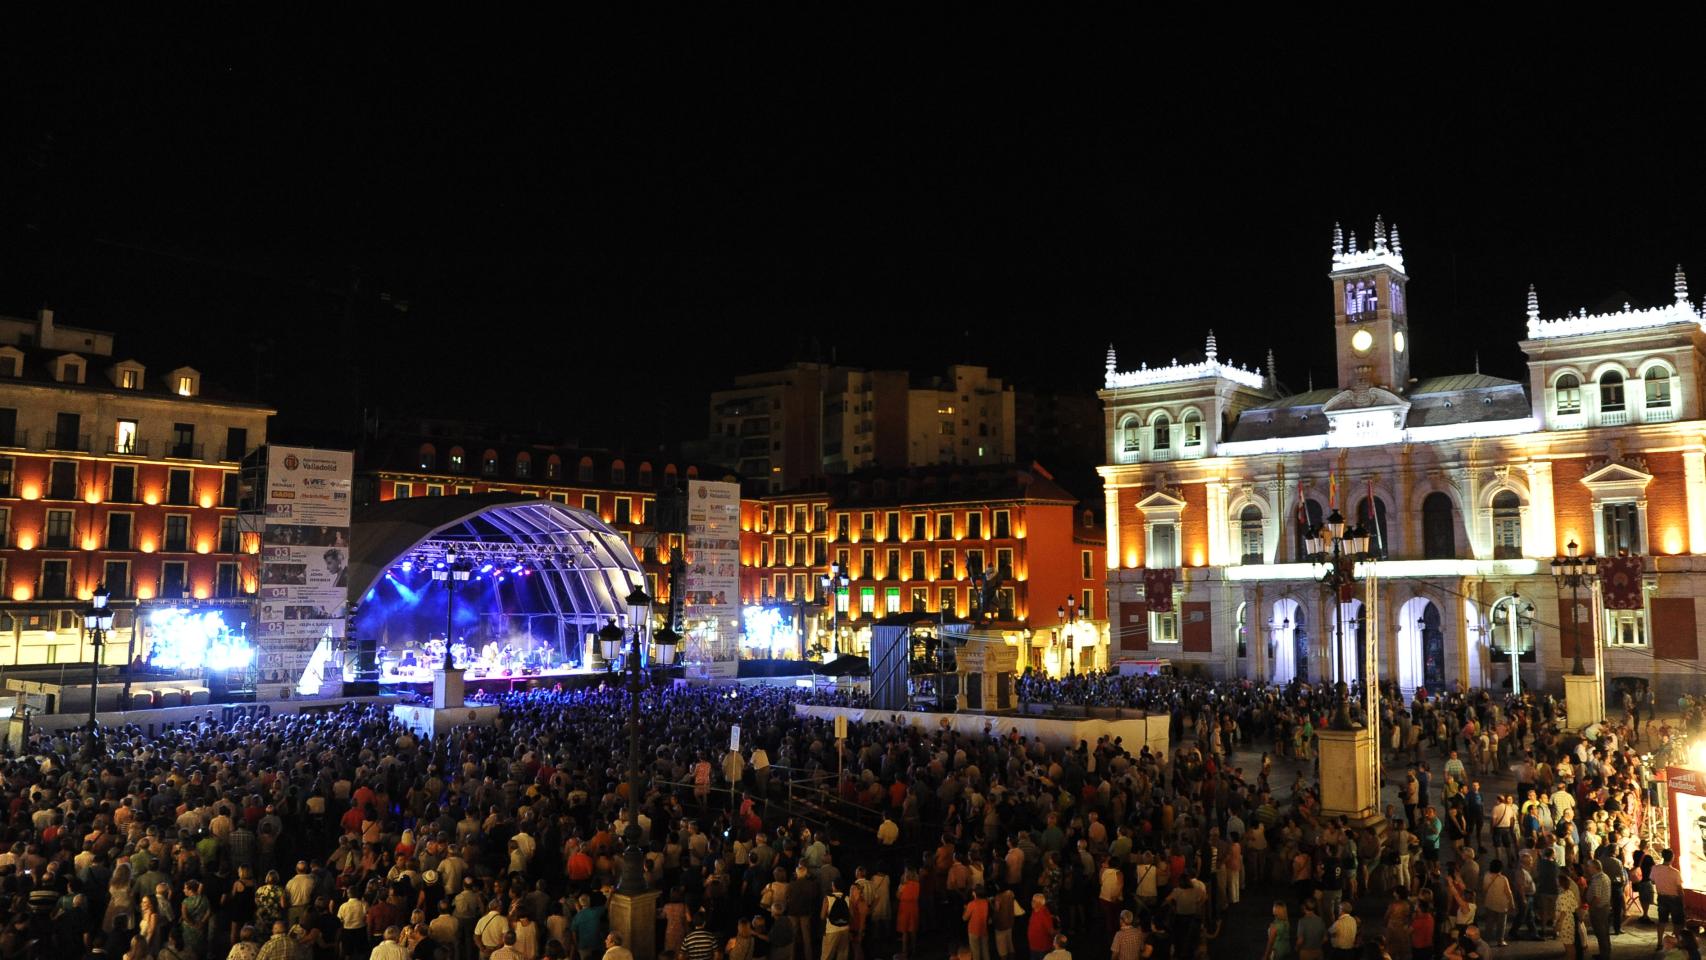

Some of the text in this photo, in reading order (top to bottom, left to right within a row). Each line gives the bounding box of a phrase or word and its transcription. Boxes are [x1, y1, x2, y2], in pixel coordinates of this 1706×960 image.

[303, 463, 336, 471] Valladolid
[277, 505, 290, 513] 02
[275, 548, 288, 557] 03
[272, 589, 286, 597] 04
[268, 623, 283, 631] 05
[267, 655, 281, 663] 06
